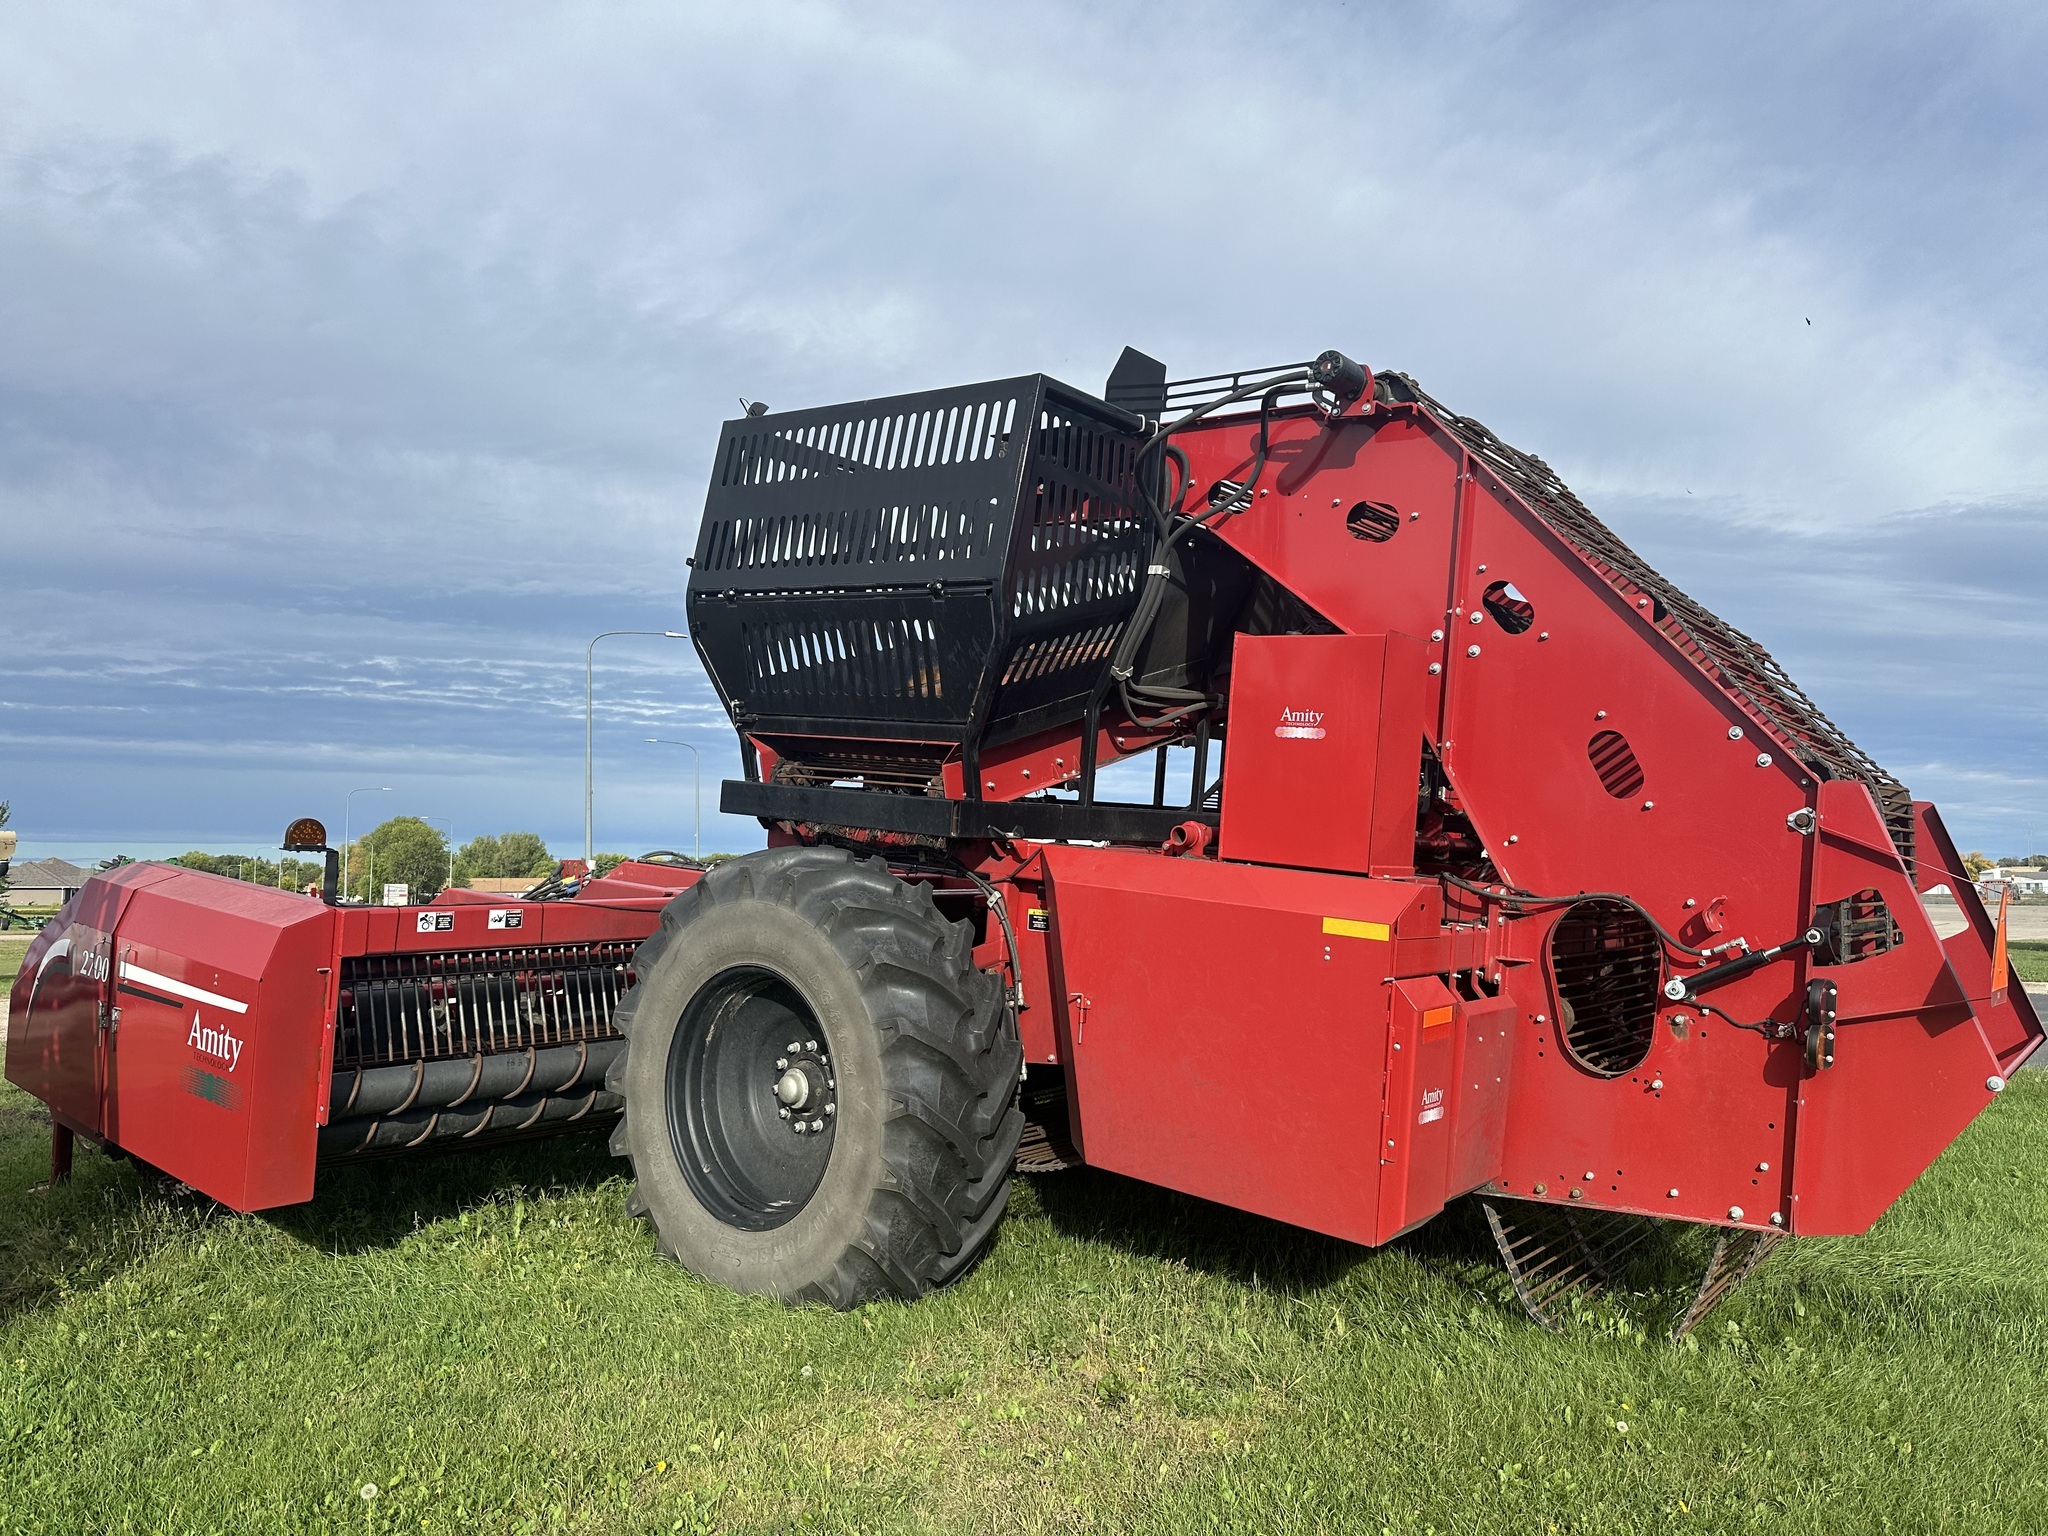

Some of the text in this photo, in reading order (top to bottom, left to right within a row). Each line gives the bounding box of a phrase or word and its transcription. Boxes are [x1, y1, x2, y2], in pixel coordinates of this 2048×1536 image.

[1280, 705, 1324, 727] Amity
[79, 949, 110, 983] 2700
[187, 1008, 244, 1073] Amity
[193, 1051, 230, 1072] TECHNOLOGY
[1421, 1087, 1444, 1106] Amity
